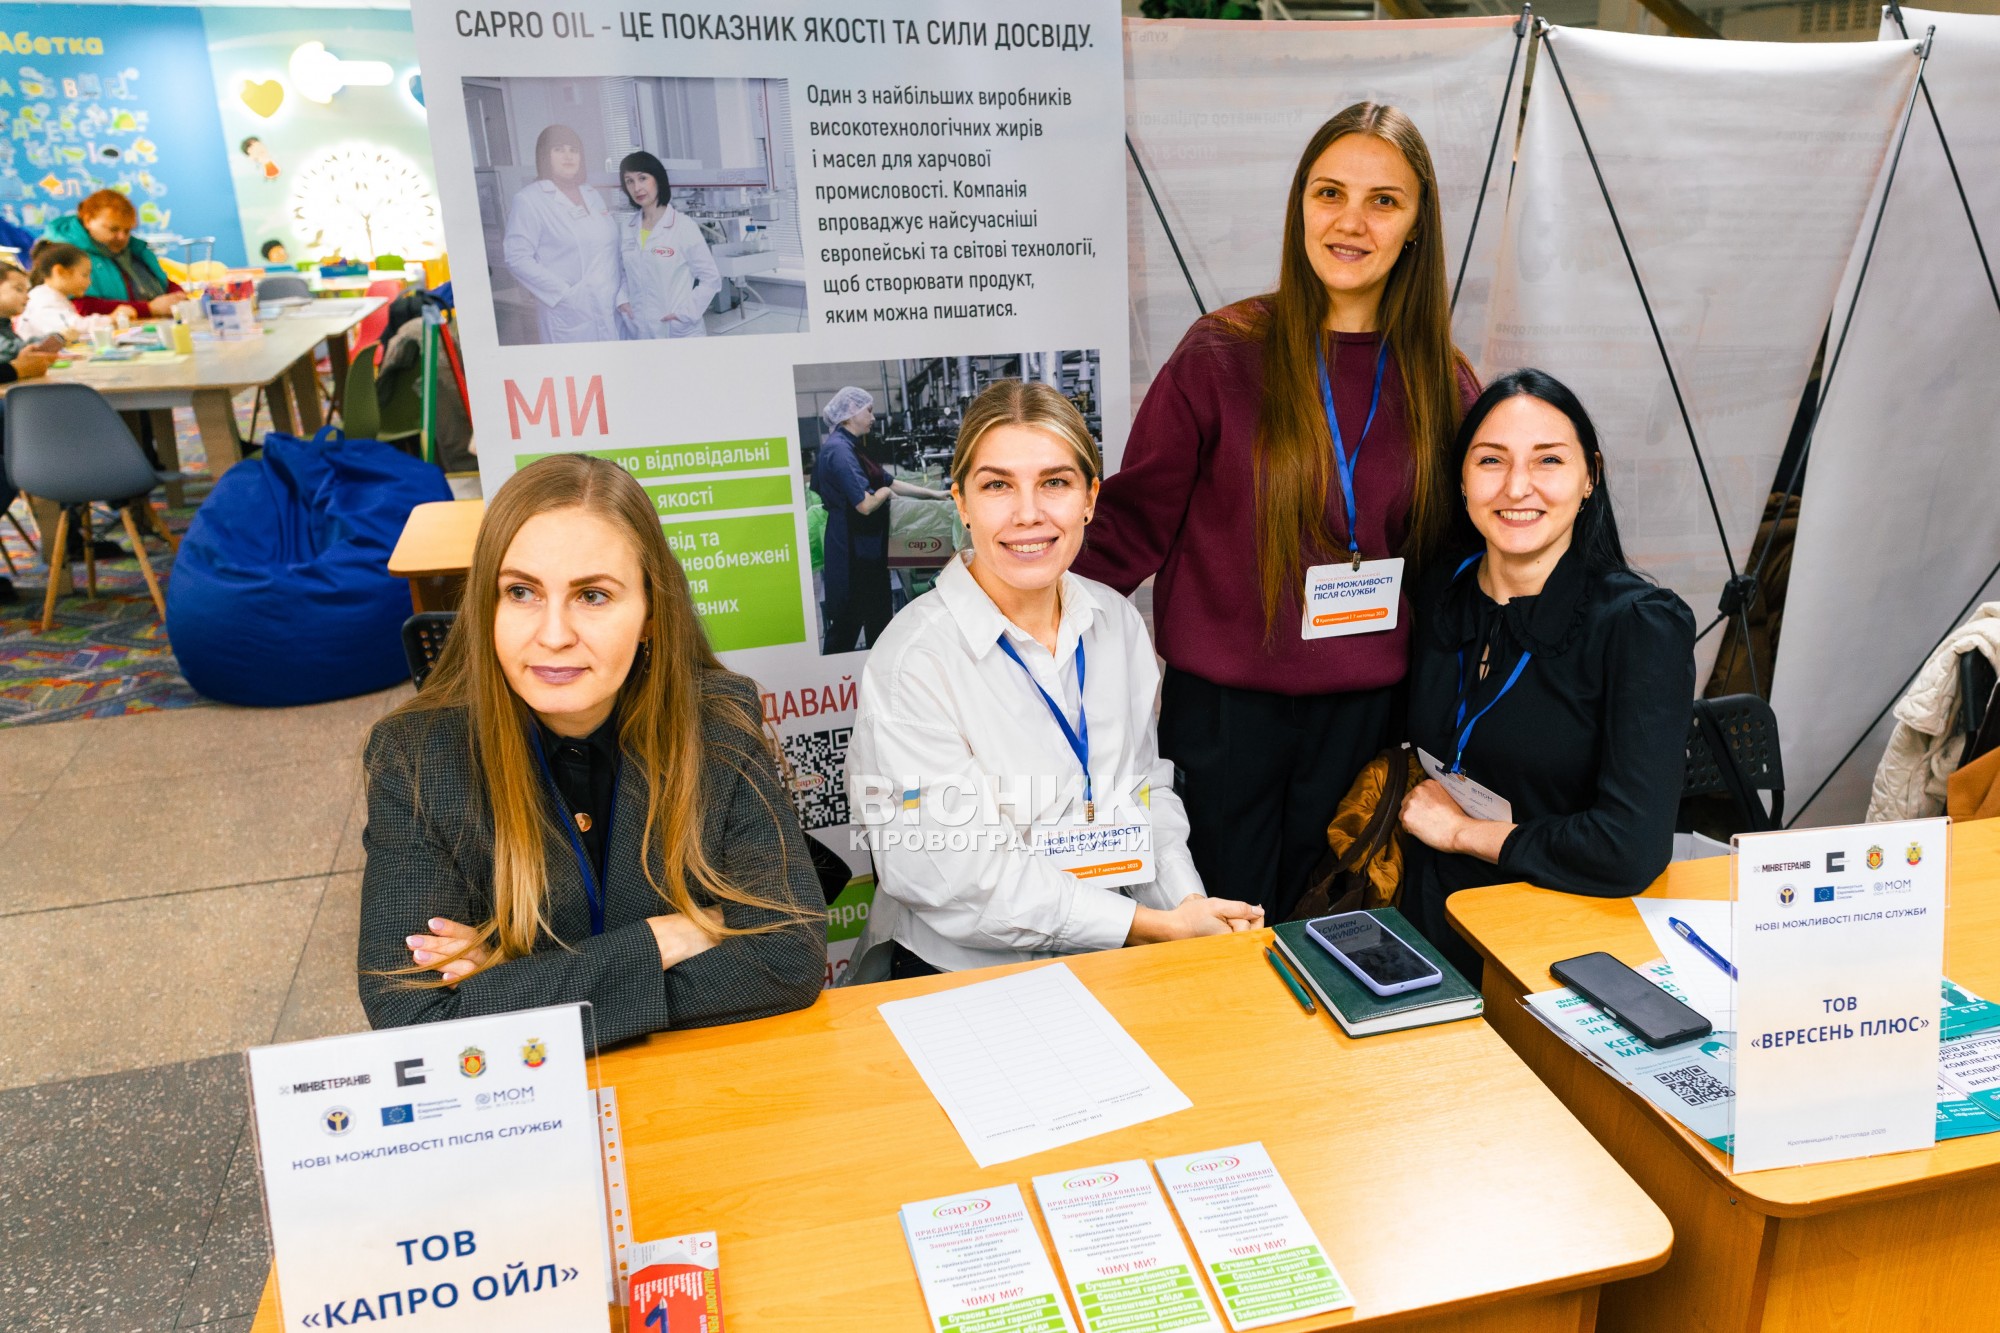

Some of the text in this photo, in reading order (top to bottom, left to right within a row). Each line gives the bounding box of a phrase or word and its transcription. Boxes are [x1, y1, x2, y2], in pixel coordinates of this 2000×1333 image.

[455, 10, 544, 38] CAPRO
[552, 12, 594, 38] OIL
[620, 11, 654, 41] ЦЕ
[661, 13, 797, 42] ПОКАЗНИК
[804, 17, 886, 44] ЯКОСТІ
[893, 20, 919, 44] ТА
[927, 20, 987, 46] СИЛИ
[995, 23, 1094, 51] ДОСВІДУ.
[807, 84, 1072, 109] Один з найбільших виробників
[810, 117, 1043, 140] високотехнологічних жирів
[812, 149, 991, 170] і масел для харчової
[815, 179, 1027, 203] промисловості. Компанія
[818, 209, 1037, 235] впроваджує найсучасніші
[821, 238, 1096, 266] європейські та світові технології,
[823, 272, 1034, 297] щоб створювати продукт,
[826, 302, 1017, 324] яким можна пишатися.
[504, 374, 609, 440] МИ
[646, 442, 770, 471] відповідальні
[657, 486, 713, 509] якості
[668, 531, 719, 551] від та
[681, 544, 790, 572] необмежені
[1314, 577, 1393, 592] НОВІ МОЖЛИВОСТІ
[1314, 587, 1376, 601] ПІСЛЯ СЛУЖБИ
[697, 599, 740, 615] вних
[1070, 826, 1141, 842] МОЖЛИВОСТІ
[1761, 860, 1811, 873] МІНВЕТЕРАНІВ
[1885, 879, 1912, 891] МОМ
[1755, 907, 1927, 932] НОВІ МОЖЛИВОСТІ ПІСЛЯ СЛУЖБИ
[1823, 996, 1857, 1013] ТОВ
[1575, 1013, 1611, 1026] ЗАП
[1604, 1035, 1641, 1049] КЕР
[1751, 1016, 1929, 1049] «ВЕРЕСЕНЬ ПЛЮС»
[293, 1074, 371, 1094] МІНВЕТЕРАНІВ
[493, 1086, 534, 1102] МОМ
[292, 1119, 563, 1170] НОВІ МОЖЛИВОСТІ ПІСЛЯ СЛУЖБИ
[939, 1202, 985, 1217] capro
[396, 1230, 477, 1266] ТОВ
[302, 1261, 579, 1329] «КАПРО ОЙЛ»
